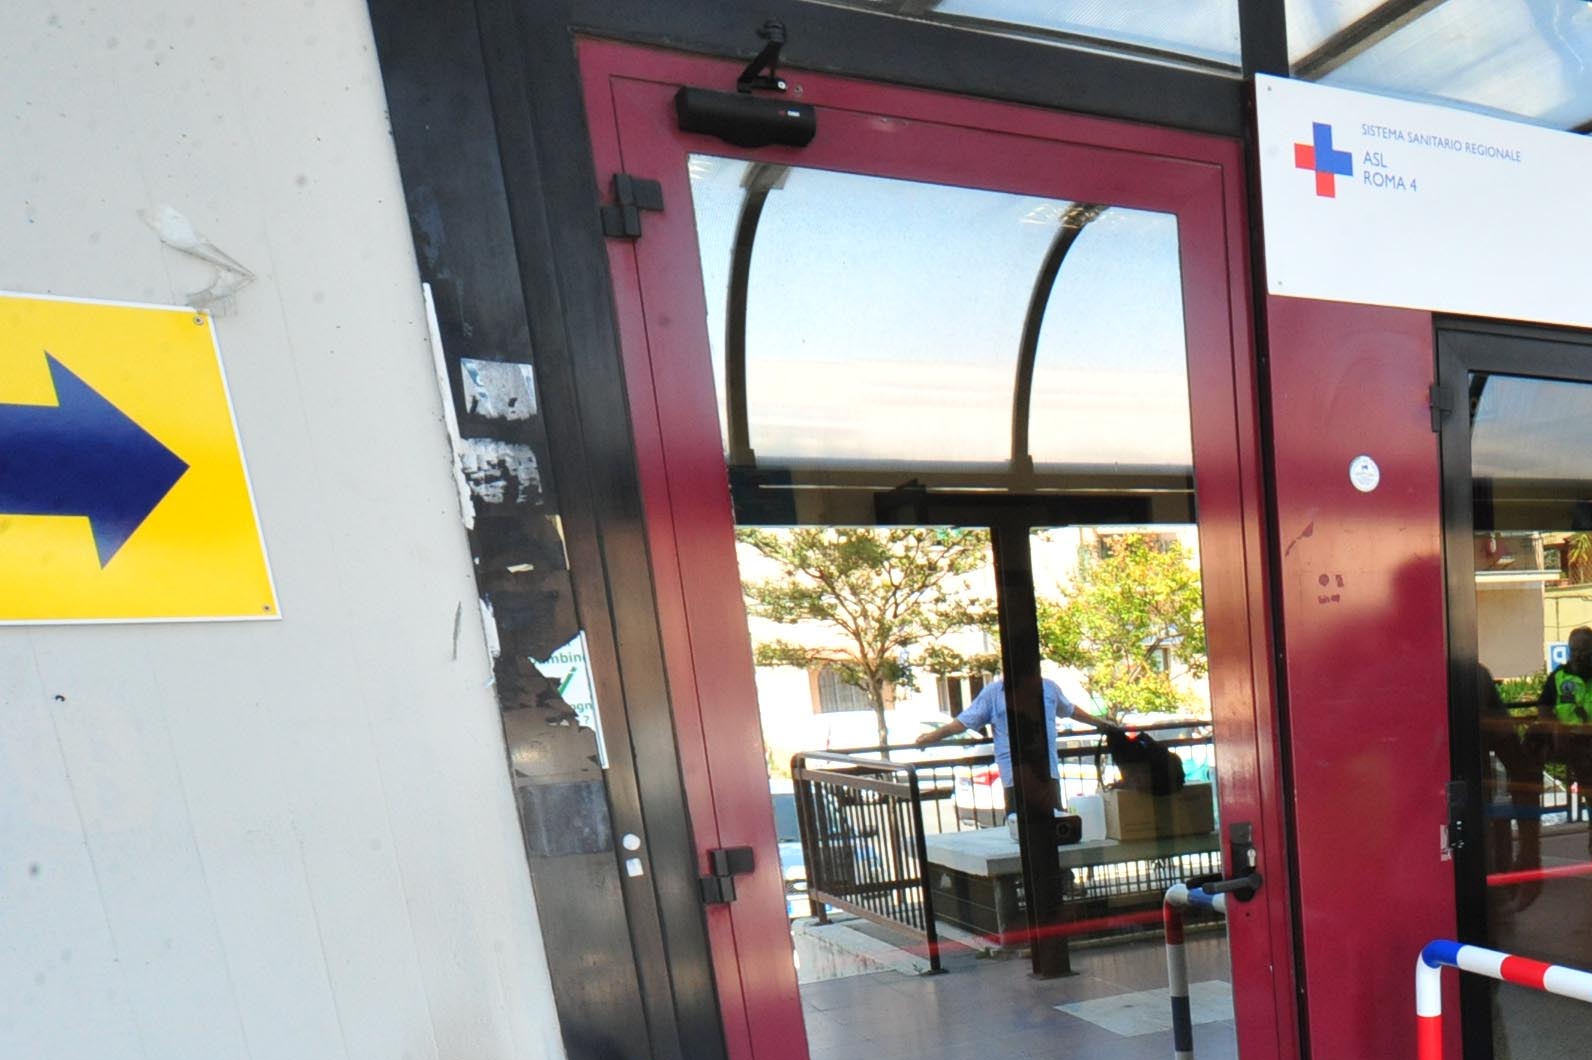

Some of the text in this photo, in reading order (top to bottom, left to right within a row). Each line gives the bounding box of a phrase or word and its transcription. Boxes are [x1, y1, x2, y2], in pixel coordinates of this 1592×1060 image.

[1361, 123, 1522, 163] SISTEMA SANITARIO REGIONALE
[1363, 151, 1388, 168] ASL
[1363, 170, 1417, 192] ROMA 4
